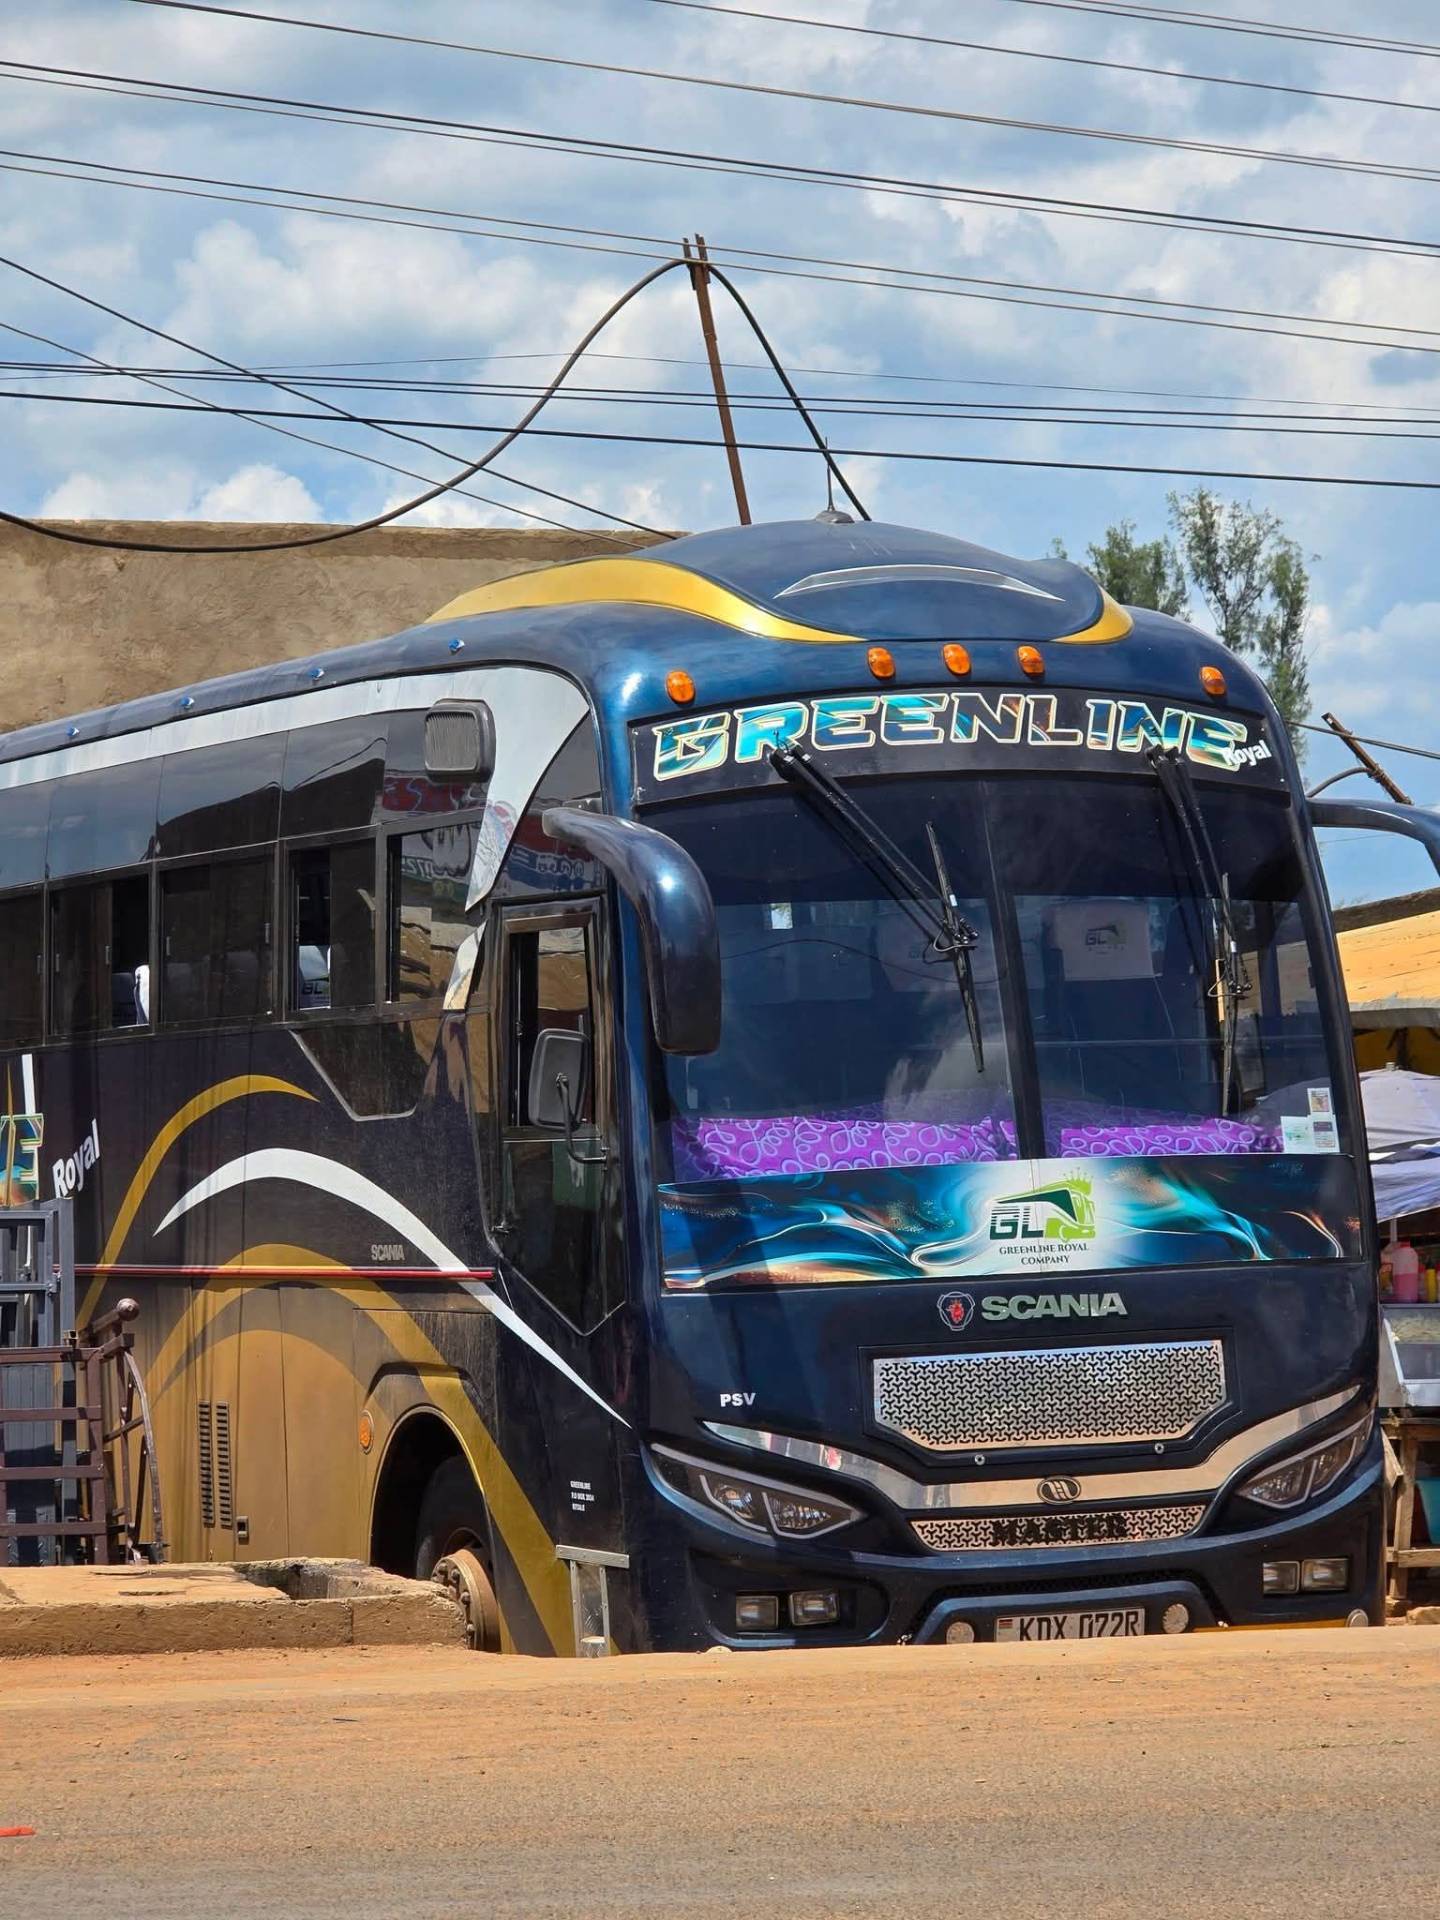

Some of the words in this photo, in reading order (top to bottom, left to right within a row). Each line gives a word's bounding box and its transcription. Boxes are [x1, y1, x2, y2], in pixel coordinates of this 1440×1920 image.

[652, 693, 1248, 781] GREENLINE
[1221, 739, 1273, 767] Royal
[52, 1118, 100, 1199] Royal
[989, 1206, 1044, 1240] GL
[371, 1244, 405, 1261] SCANIA
[999, 1246, 1056, 1255] GREENLINE
[1058, 1243, 1089, 1253] ROYAL
[1021, 1255, 1070, 1265] COMPANY
[981, 1293, 1128, 1321] SCANIA
[720, 1392, 756, 1407] PSV
[989, 1511, 1128, 1547] MASTER
[1019, 1615, 1067, 1641] KDX
[1079, 1610, 1138, 1640] 072R
